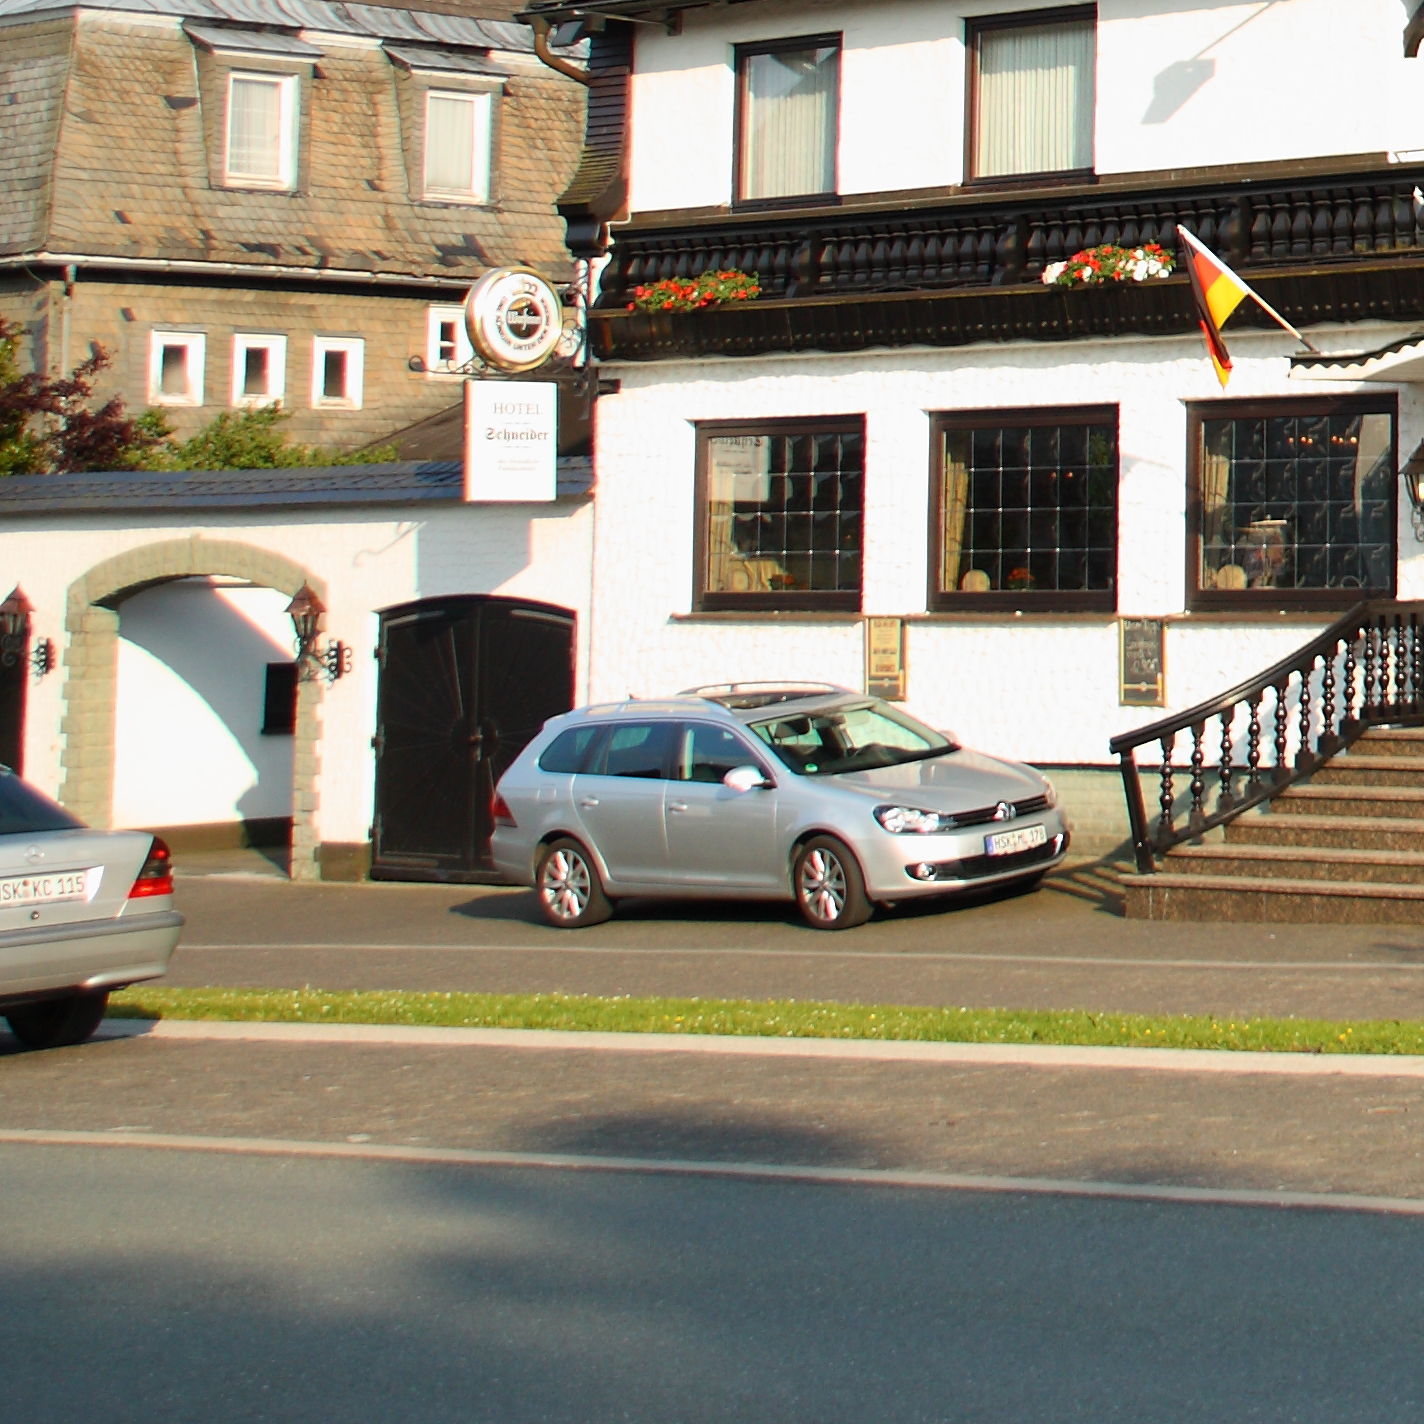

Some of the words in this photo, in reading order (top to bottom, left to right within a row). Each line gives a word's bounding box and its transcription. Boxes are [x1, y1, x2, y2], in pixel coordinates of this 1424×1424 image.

[493, 402, 544, 415] HOTEL
[485, 427, 549, 442] Schneider
[33, 879, 52, 896] KC
[57, 875, 85, 895] 115
